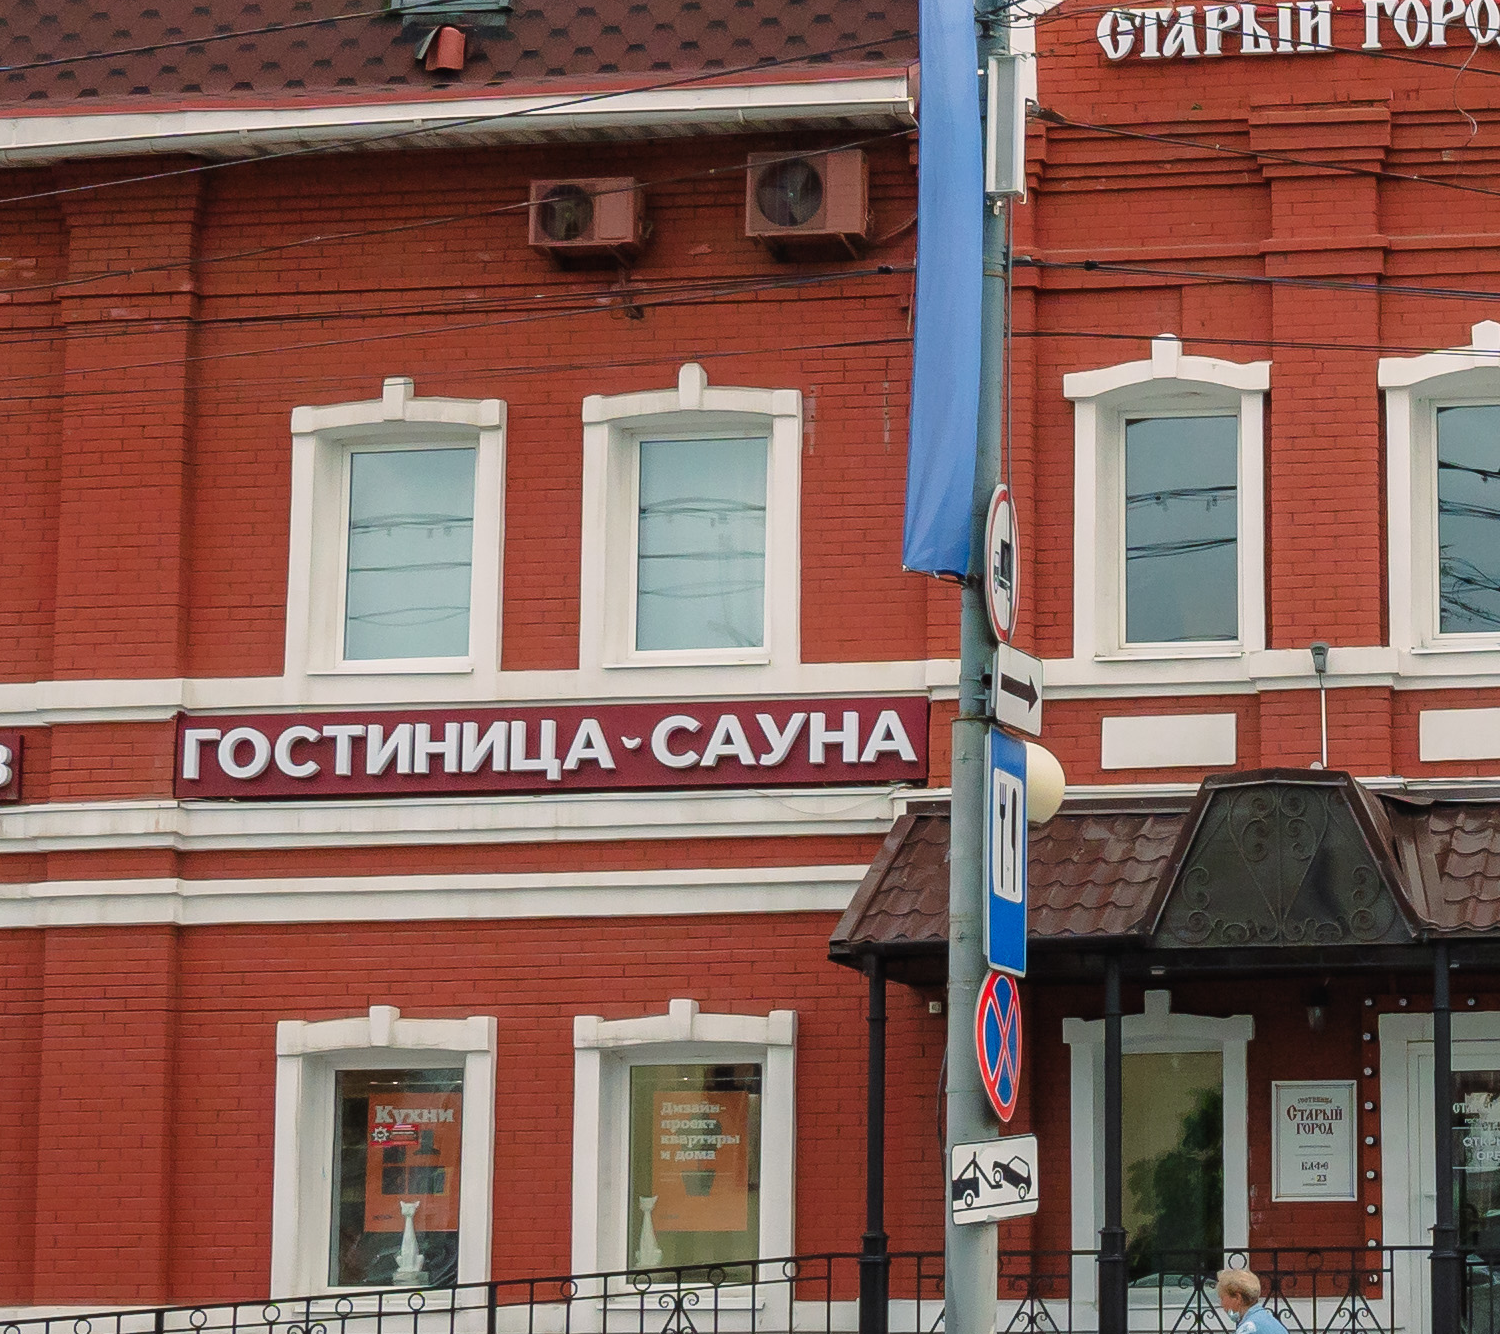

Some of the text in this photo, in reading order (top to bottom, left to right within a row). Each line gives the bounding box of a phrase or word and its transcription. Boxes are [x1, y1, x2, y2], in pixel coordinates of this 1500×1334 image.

[182, 710, 918, 782] ГОСТИНИЦА САУНА
[375, 1105, 455, 1124] Кухни
[1296, 1123, 1334, 1136] ГОРОД
[660, 1135, 740, 1149] квартиры
